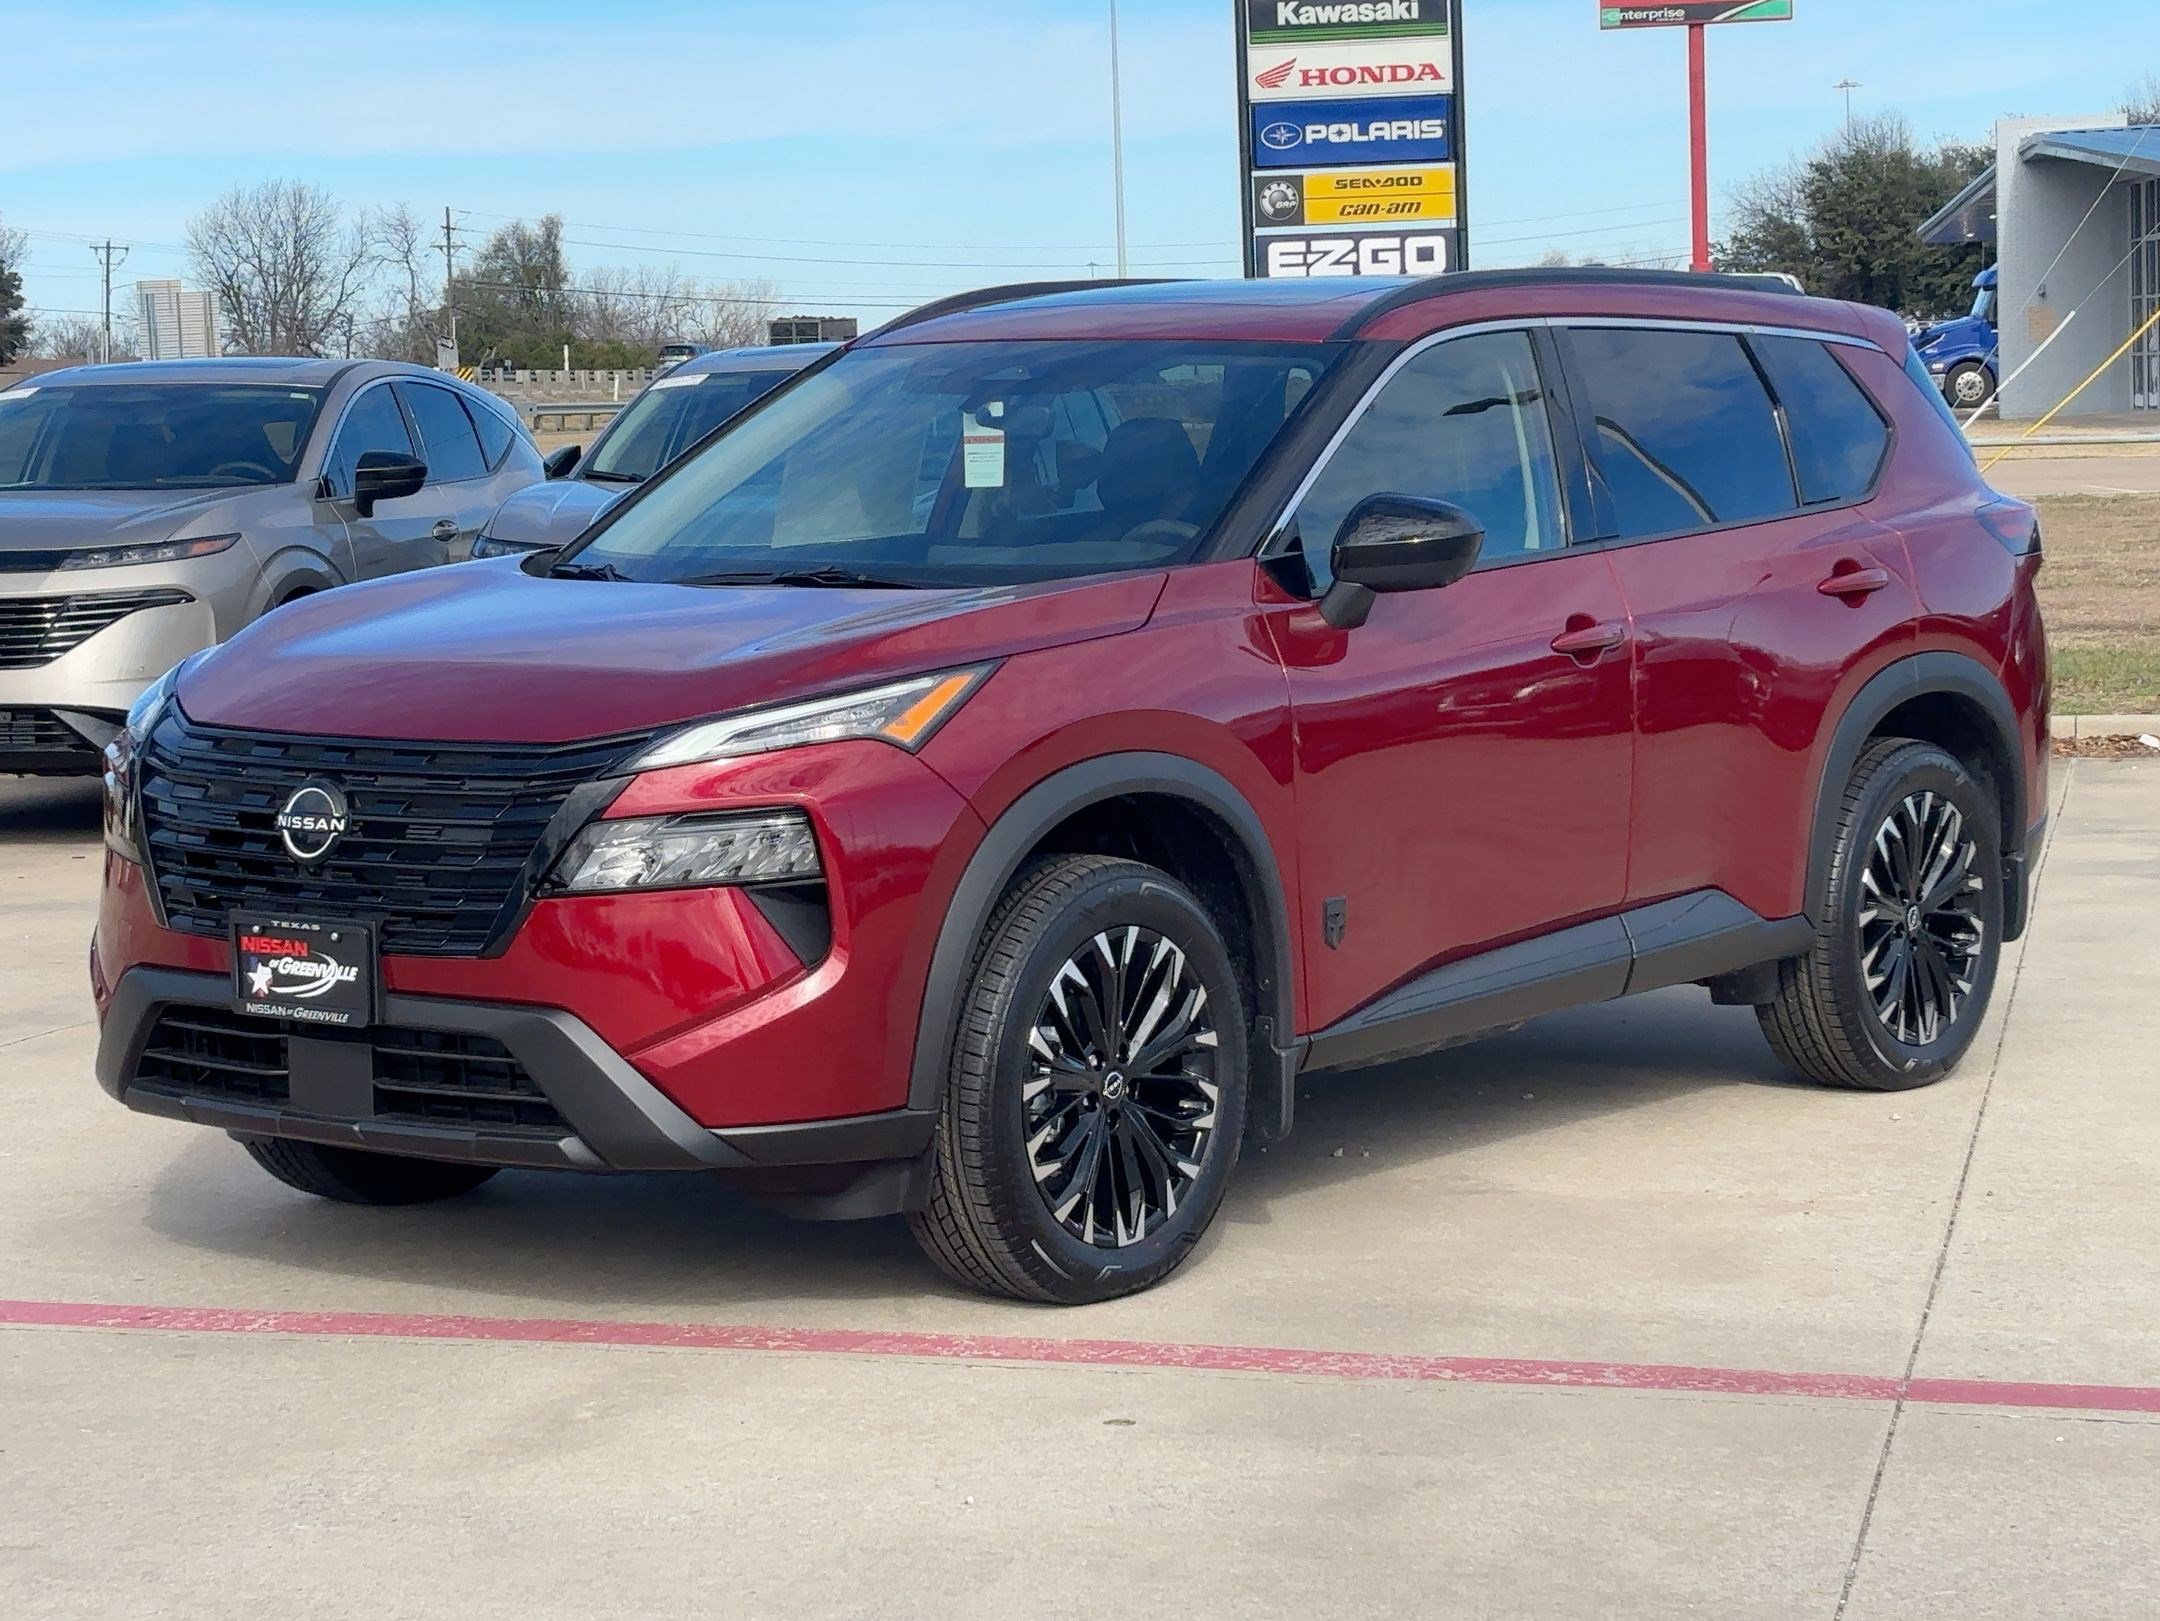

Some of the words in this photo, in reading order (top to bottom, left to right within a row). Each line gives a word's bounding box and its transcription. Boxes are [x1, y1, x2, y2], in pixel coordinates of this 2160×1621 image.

[1277, 0, 1419, 26] Kawasaki
[1602, 7, 1685, 21] enterprise
[1299, 63, 1446, 88] HONDA
[1305, 119, 1444, 144] POLARIS
[1275, 201, 1298, 209] BRP
[1339, 201, 1422, 217] can-am
[1267, 235, 1446, 278] EZGO
[278, 813, 345, 832] NISSAN
[270, 920, 321, 931] TEXAS
[240, 936, 309, 957] NISSAN
[246, 1002, 287, 1016] NISSAN
[293, 1007, 350, 1024] GREENVILLE
